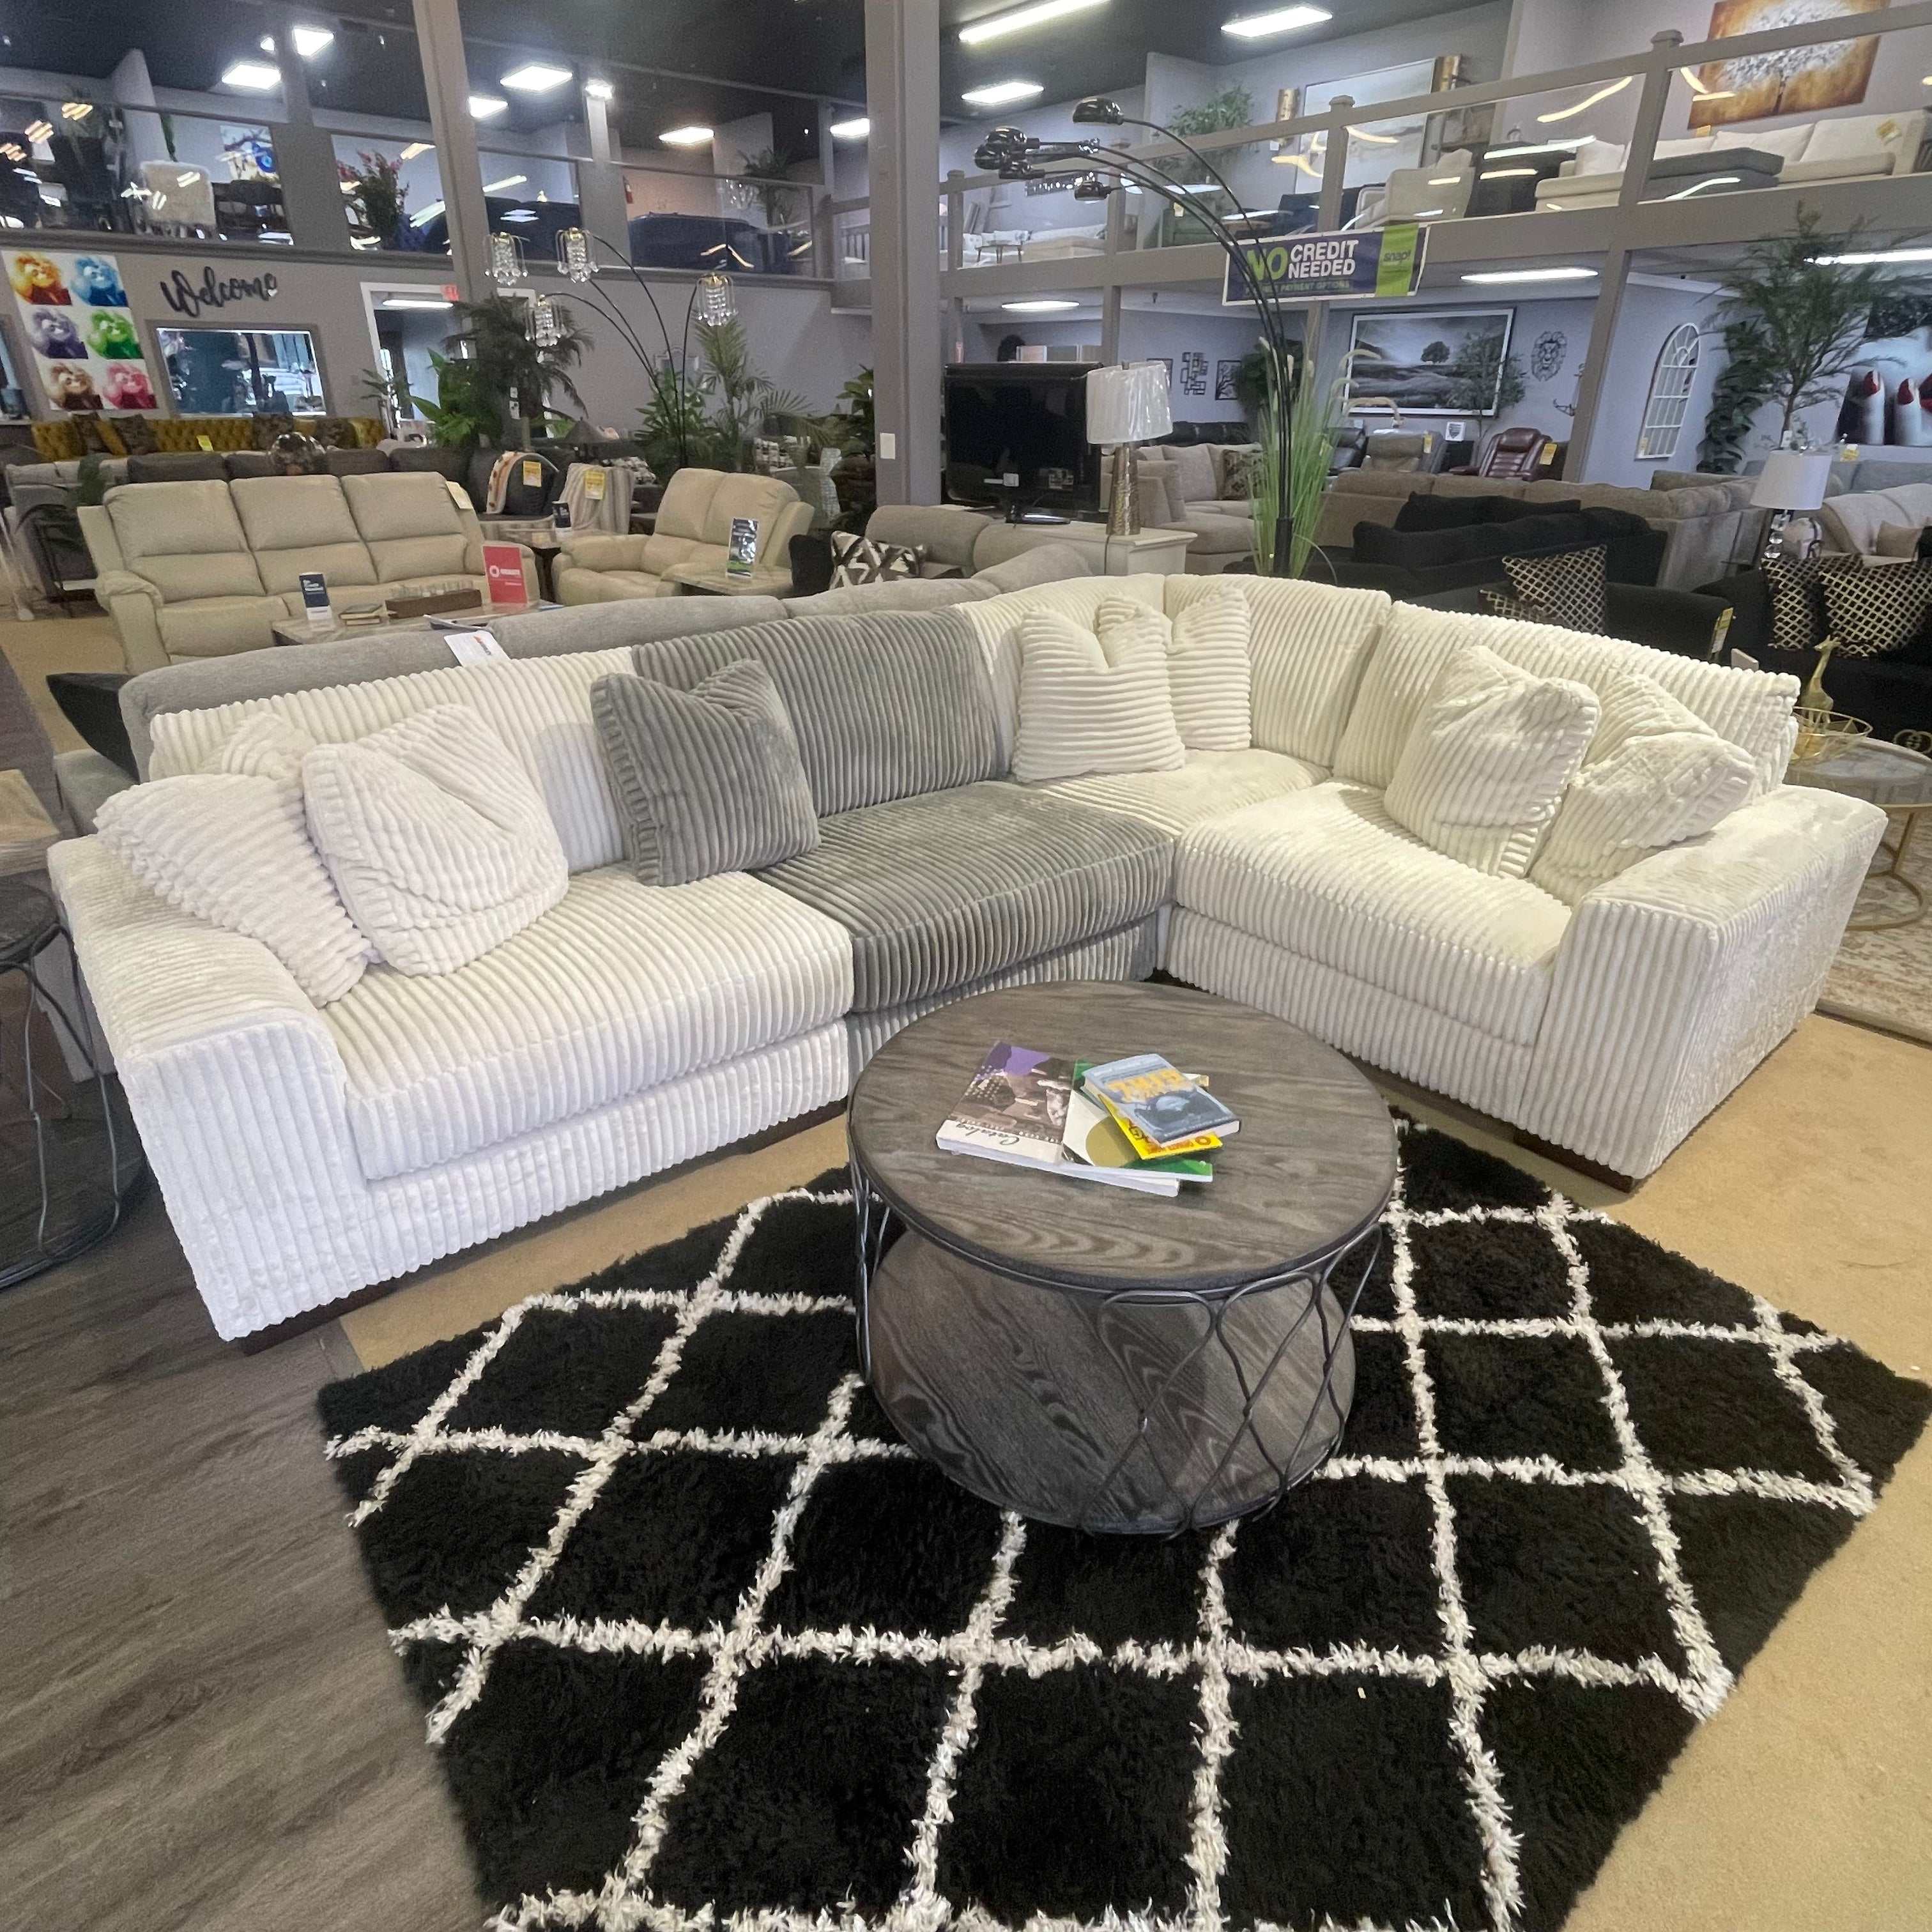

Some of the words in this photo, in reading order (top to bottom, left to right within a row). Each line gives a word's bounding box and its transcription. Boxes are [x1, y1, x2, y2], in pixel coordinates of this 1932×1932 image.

[1246, 246, 1289, 281] NO
[1290, 240, 1360, 263] CREDIT
[1287, 258, 1356, 279] NEEDED
[160, 266, 279, 318] Welcome
[956, 1123, 1020, 1146] Catalog
